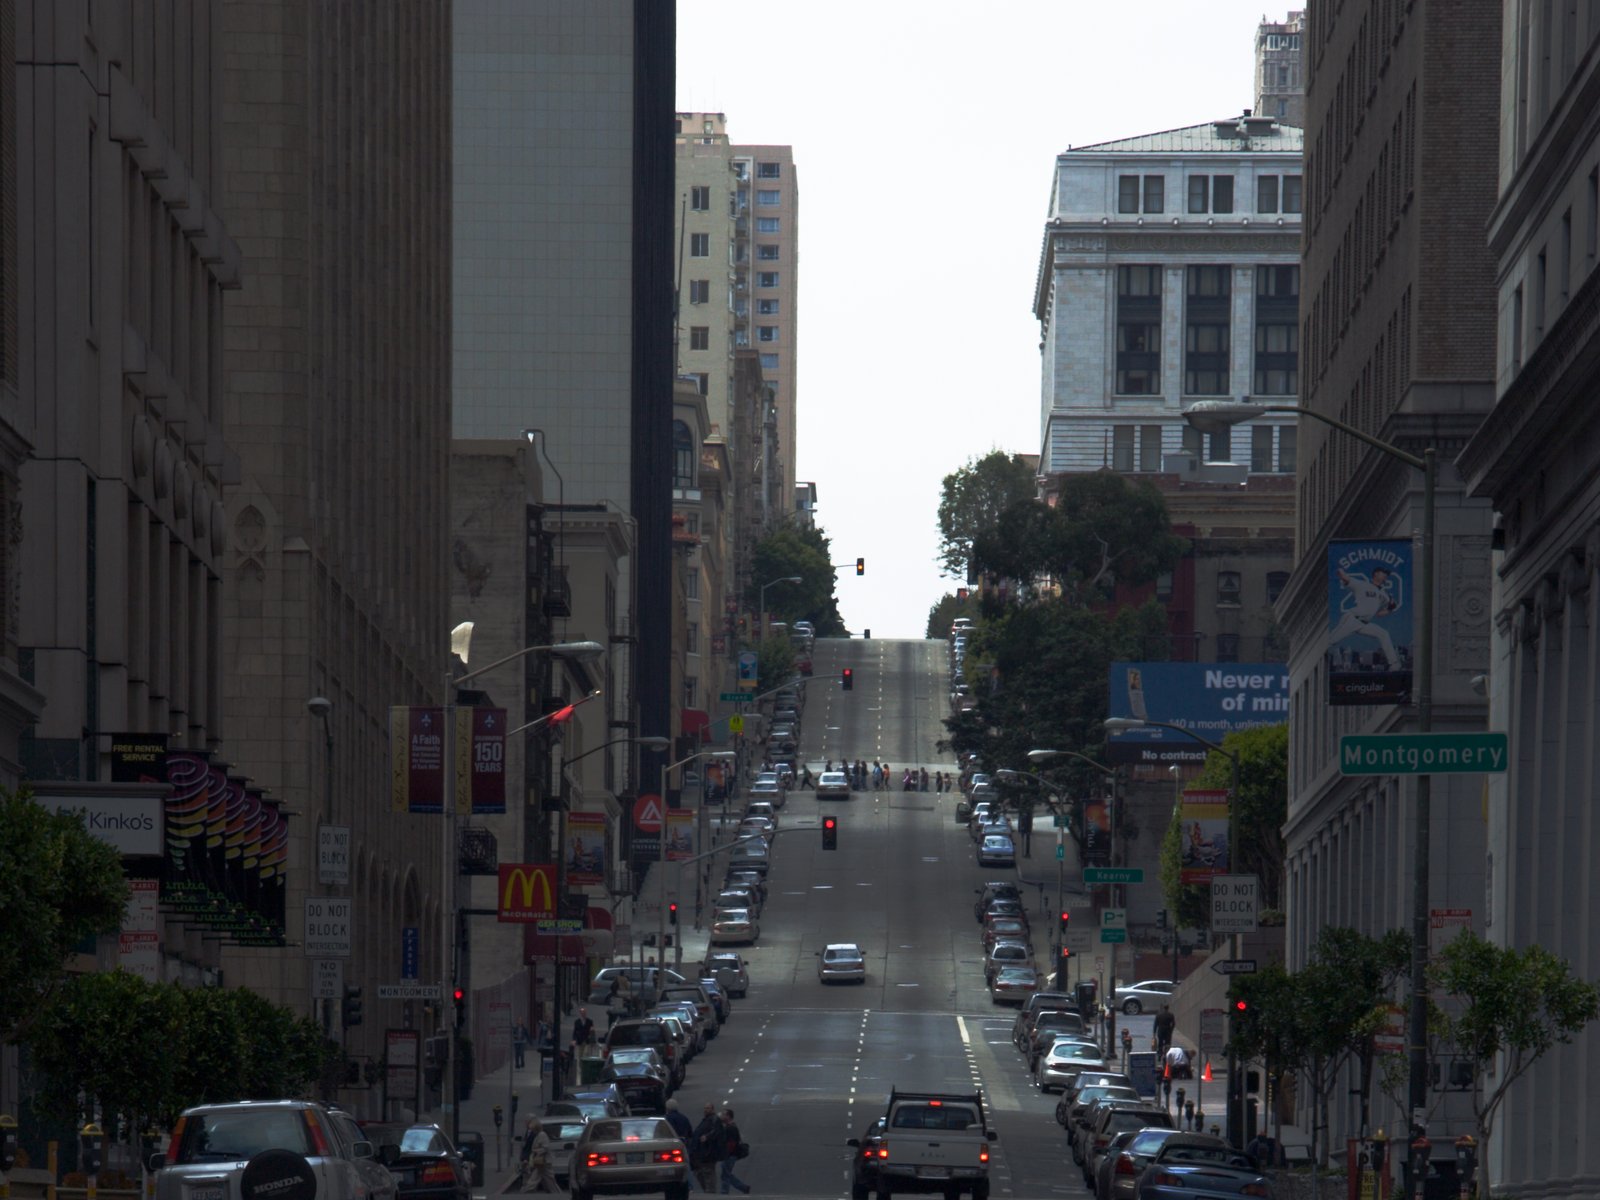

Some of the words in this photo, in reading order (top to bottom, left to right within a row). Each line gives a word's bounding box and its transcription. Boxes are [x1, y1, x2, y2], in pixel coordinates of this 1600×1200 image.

[1339, 548, 1404, 569] SCHMIDT
[1205, 670, 1274, 689] Never
[1345, 683, 1384, 695] cingular
[1222, 693, 1246, 711] of
[1198, 719, 1233, 730] month,
[412, 735, 418, 745] A
[419, 735, 440, 745] Faith
[122, 754, 156, 762] SERVICE
[475, 742, 503, 762] 150
[1142, 751, 1157, 760] No
[1159, 751, 1207, 760] contract
[1345, 745, 1503, 770] Montgomery
[475, 762, 502, 772] YEARS
[90, 812, 153, 830] Kinko's
[321, 833, 331, 845] DO
[334, 833, 348, 846] NOT
[321, 851, 347, 865] BLOCK
[1097, 871, 1131, 881] Kearny
[1213, 884, 1228, 896] DO
[1234, 884, 1254, 896] NOT
[308, 904, 322, 917] DO
[328, 904, 347, 917] NOT
[1215, 901, 1253, 912] BLOCK
[309, 924, 347, 936] BLOCK
[120, 943, 132, 953] NO
[307, 942, 349, 950] INTERSECTION
[320, 962, 336, 970] NO
[380, 988, 439, 997] MONTGOMERY
[253, 1176, 304, 1194] HONDA
